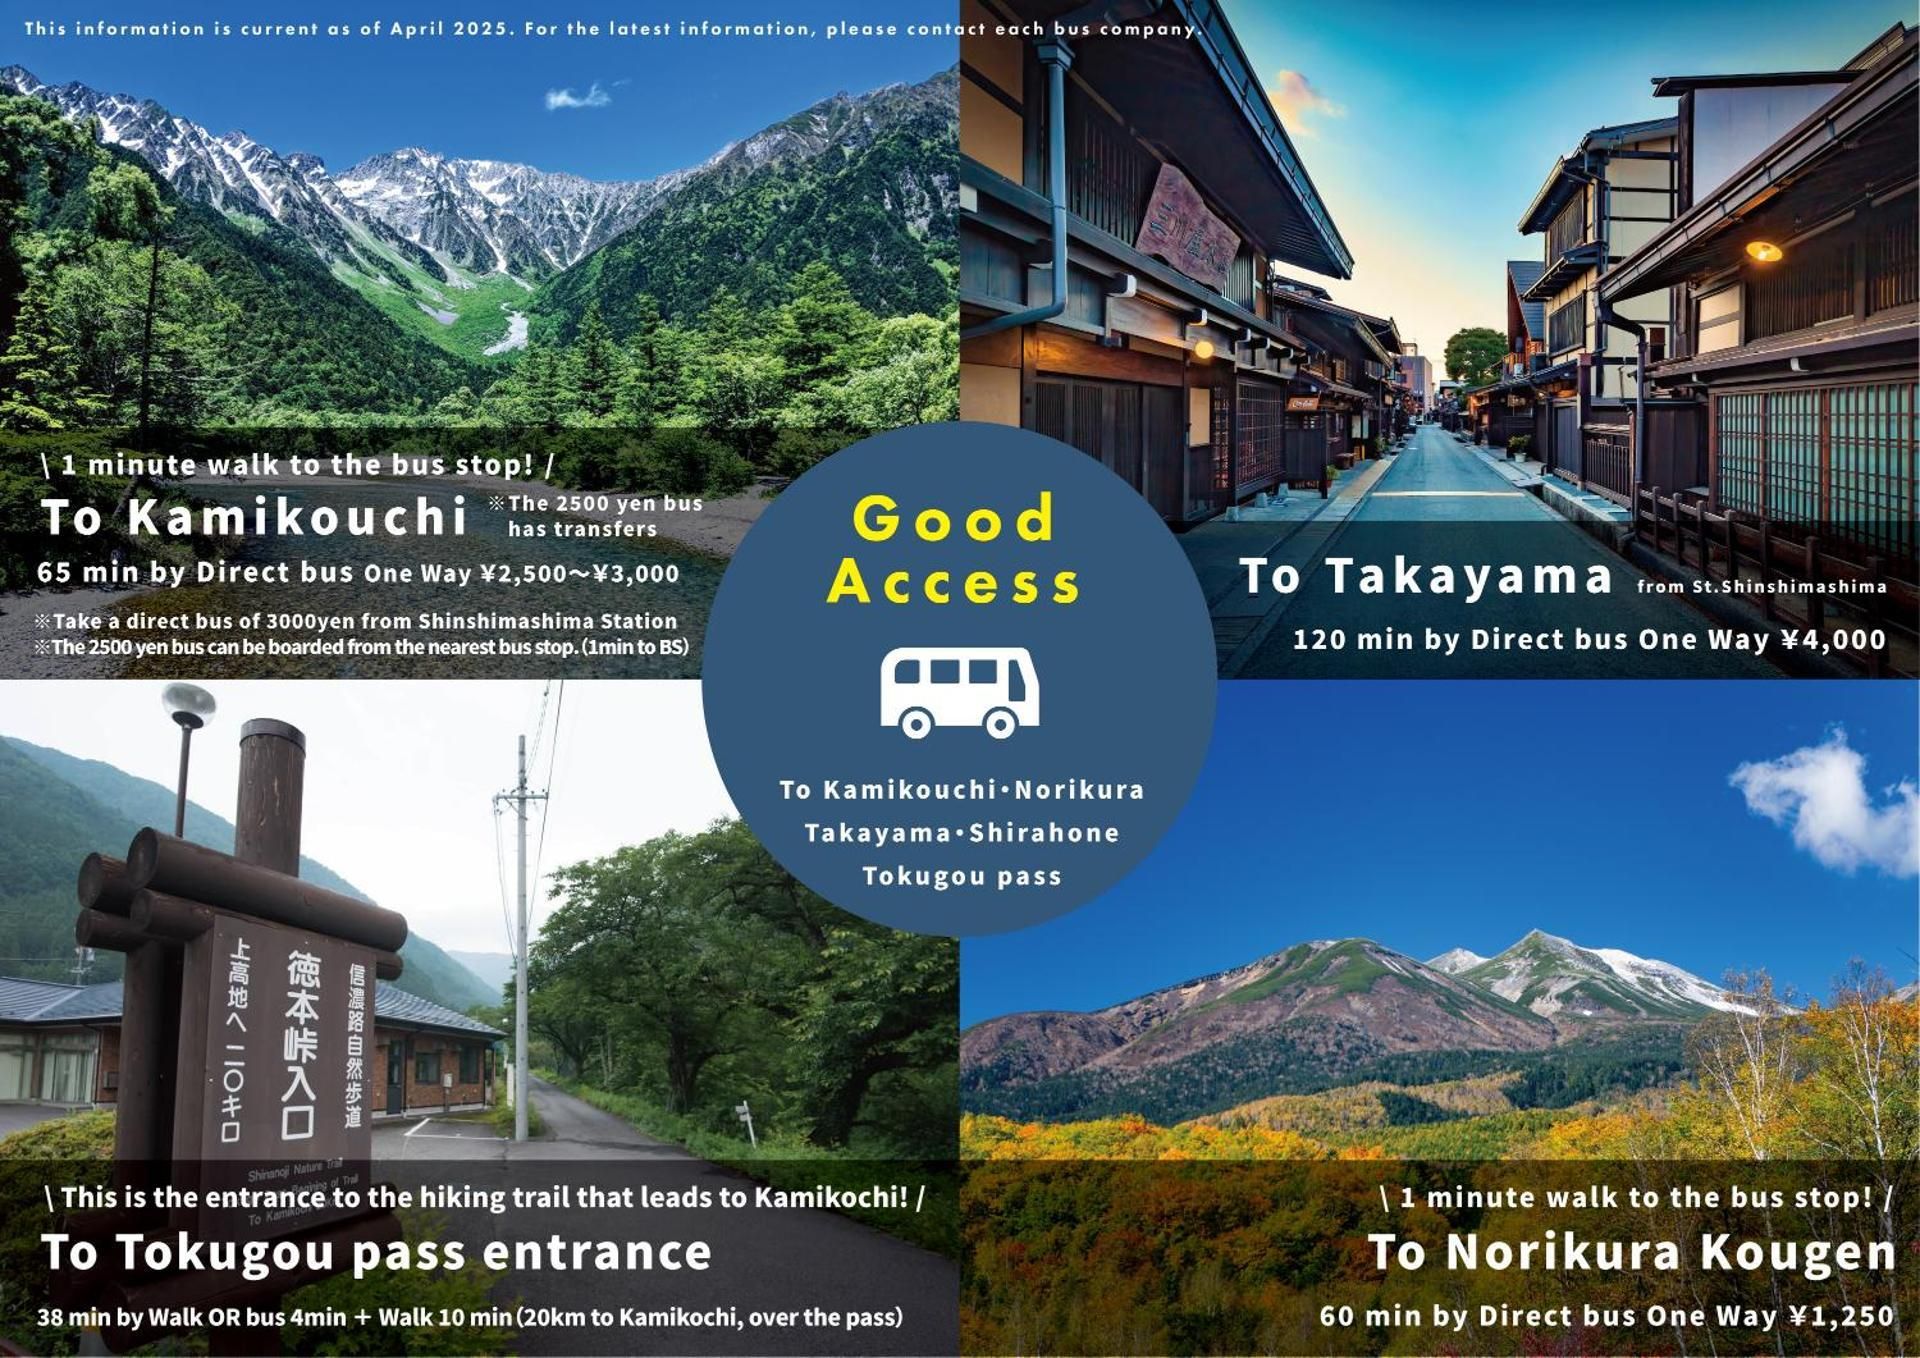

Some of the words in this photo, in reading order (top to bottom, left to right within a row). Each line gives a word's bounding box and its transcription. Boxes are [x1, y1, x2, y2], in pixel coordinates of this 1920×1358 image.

[281, 949, 322, 1141] 徳本峠入口
[344, 962, 366, 1129] 信濃路自然歩道
[247, 1165, 289, 1183] Shinanoji
[248, 1213, 261, 1227] To
